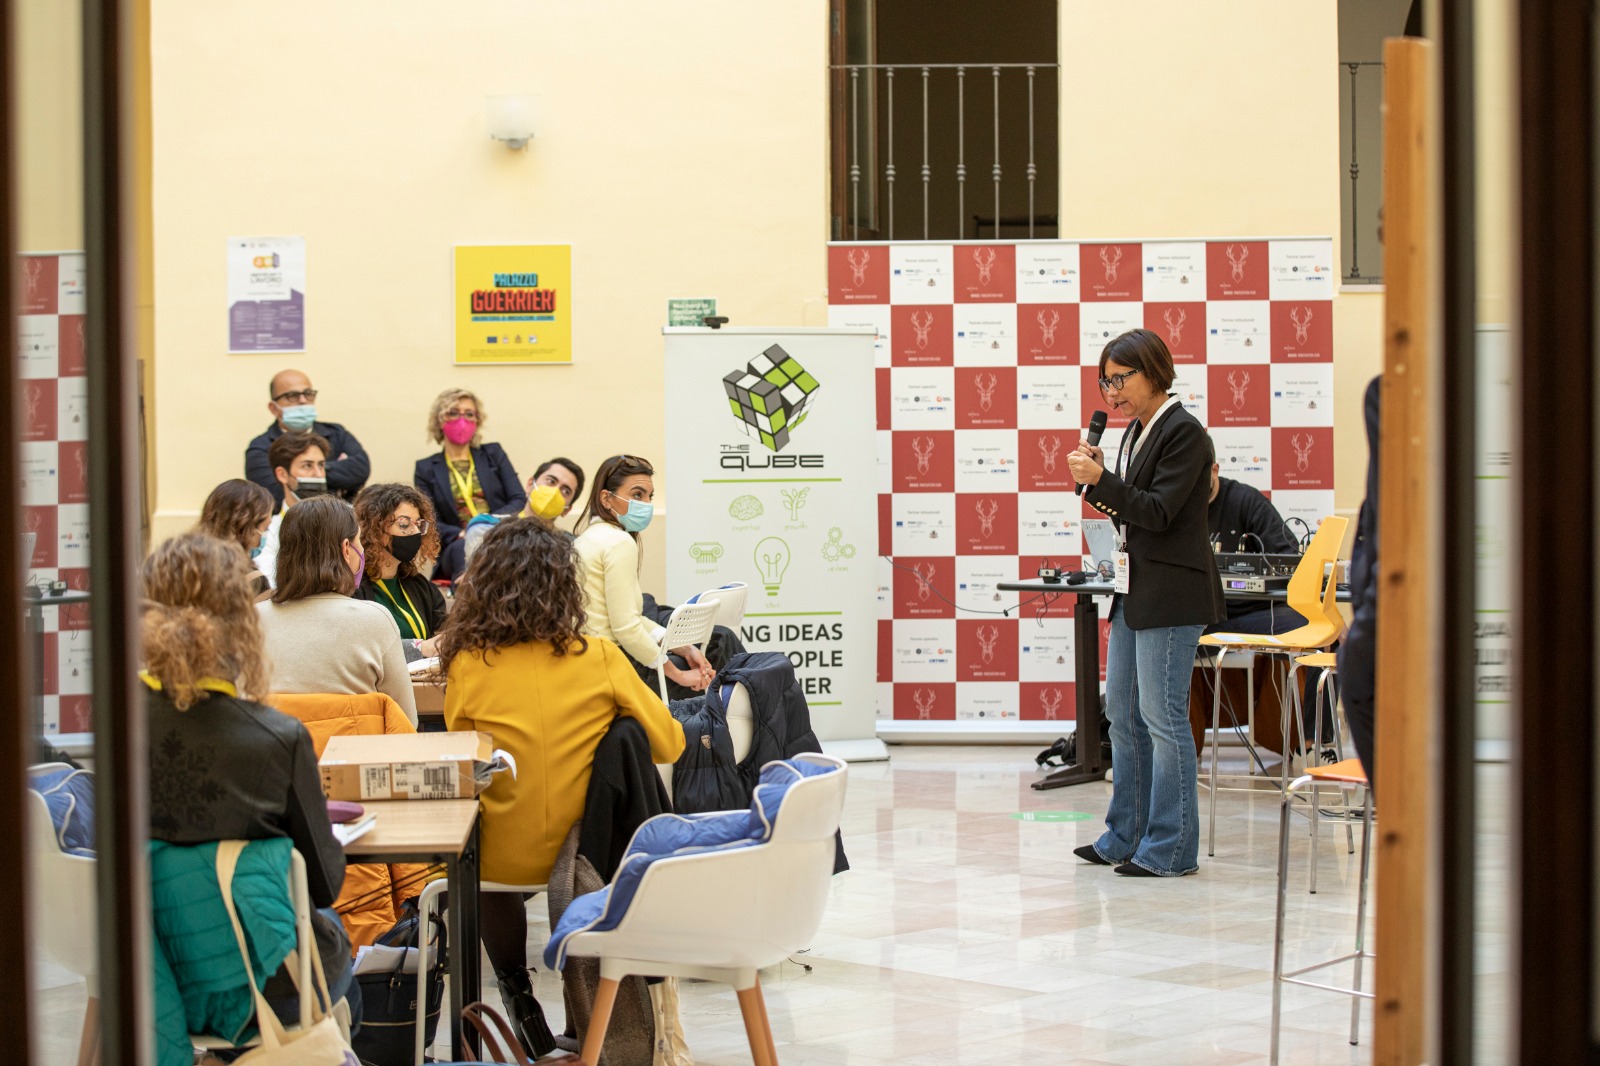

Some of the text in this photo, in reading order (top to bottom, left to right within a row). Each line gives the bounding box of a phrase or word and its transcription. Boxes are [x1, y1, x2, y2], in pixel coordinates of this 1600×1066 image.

[494, 273, 538, 287] PALAZZO
[471, 288, 556, 313] GUERRIERI
[720, 455, 824, 472] QUBE
[741, 623, 843, 643] NG IDEAS
[787, 650, 843, 669] OPLE
